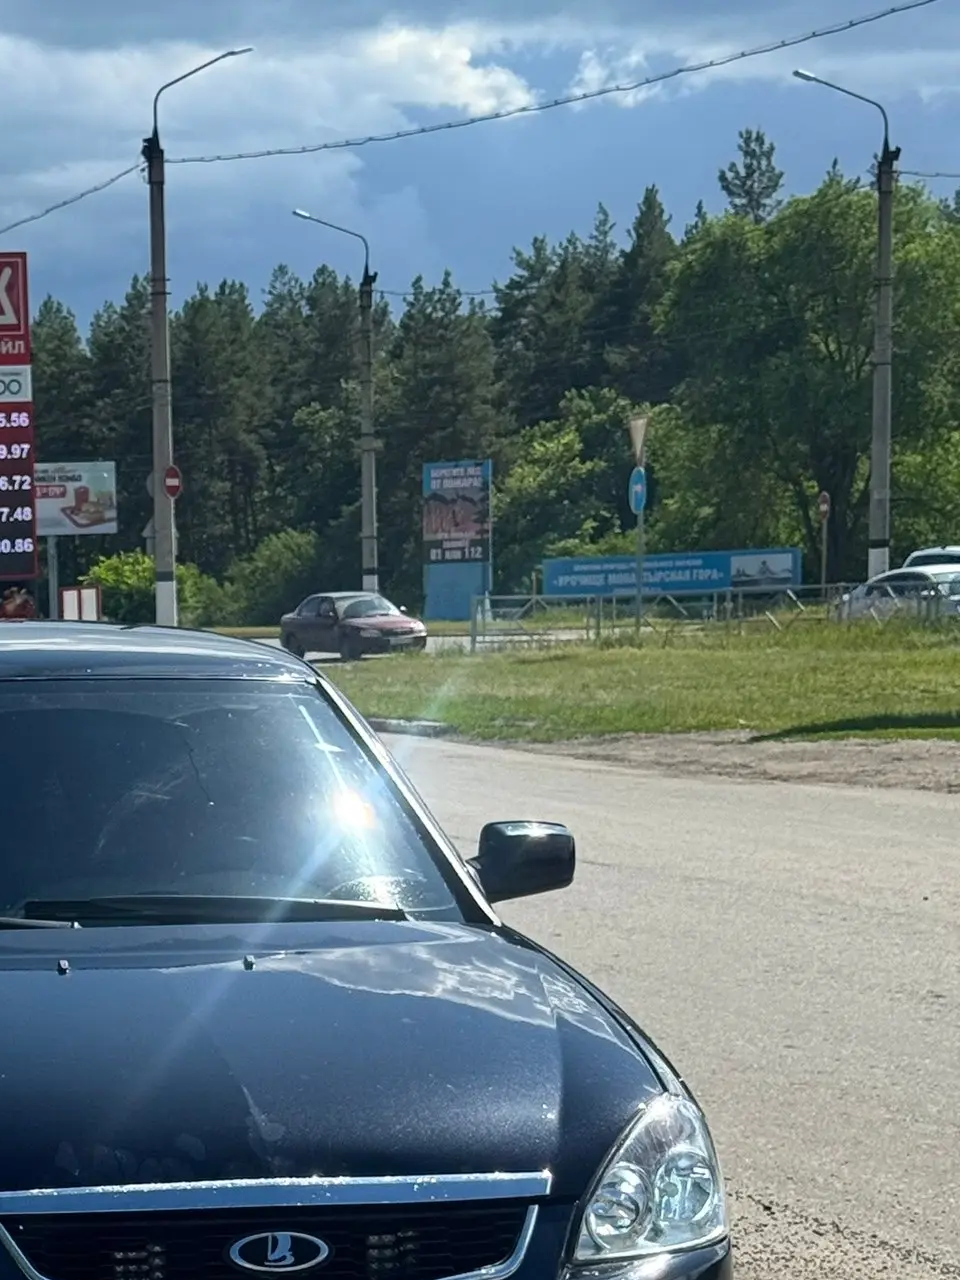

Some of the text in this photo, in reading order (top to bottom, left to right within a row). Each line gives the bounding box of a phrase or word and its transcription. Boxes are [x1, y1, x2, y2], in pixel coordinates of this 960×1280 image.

[430, 548, 442, 560] 01
[464, 546, 483, 559] 112
[607, 569, 690, 586] МОНАТЫРСКАЯ
